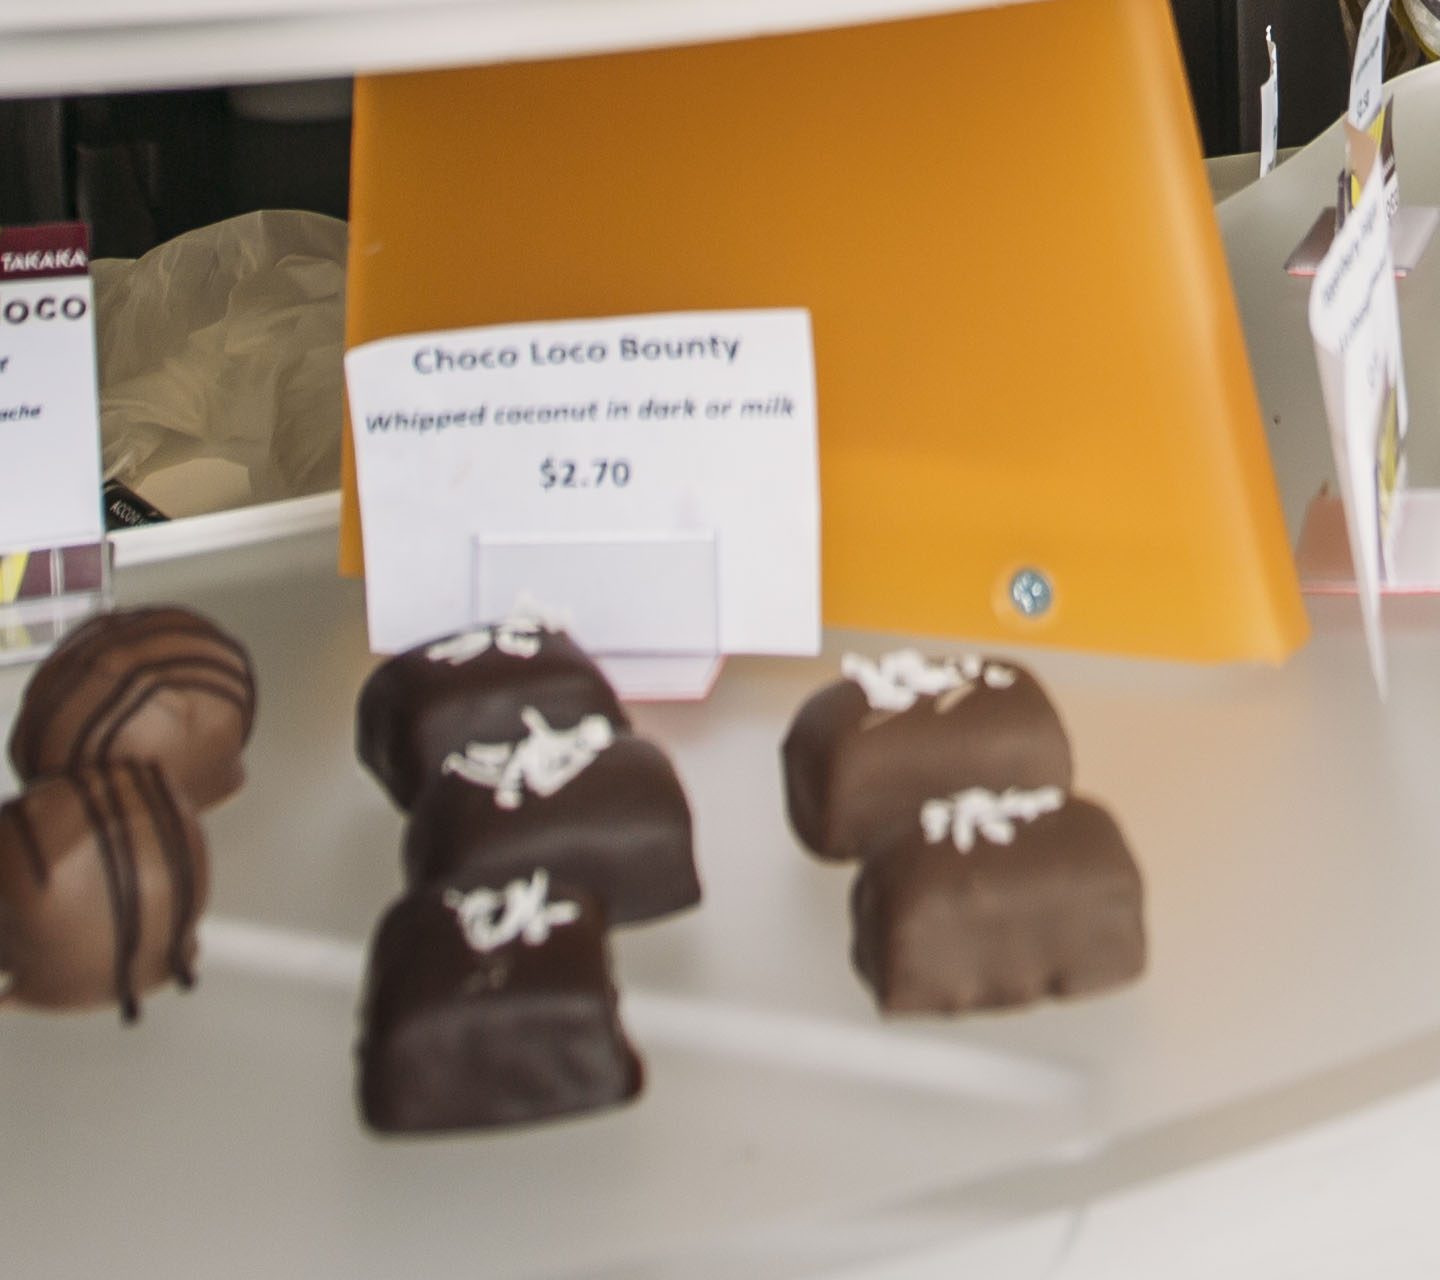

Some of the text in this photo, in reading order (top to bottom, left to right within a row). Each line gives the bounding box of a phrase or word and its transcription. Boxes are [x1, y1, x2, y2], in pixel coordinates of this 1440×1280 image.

[1, 247, 86, 273] TAKAKA
[413, 333, 740, 375] Choco Loco Bounty
[364, 394, 795, 435] Whipped coconut in dark or milk
[539, 456, 633, 491] $2.70
